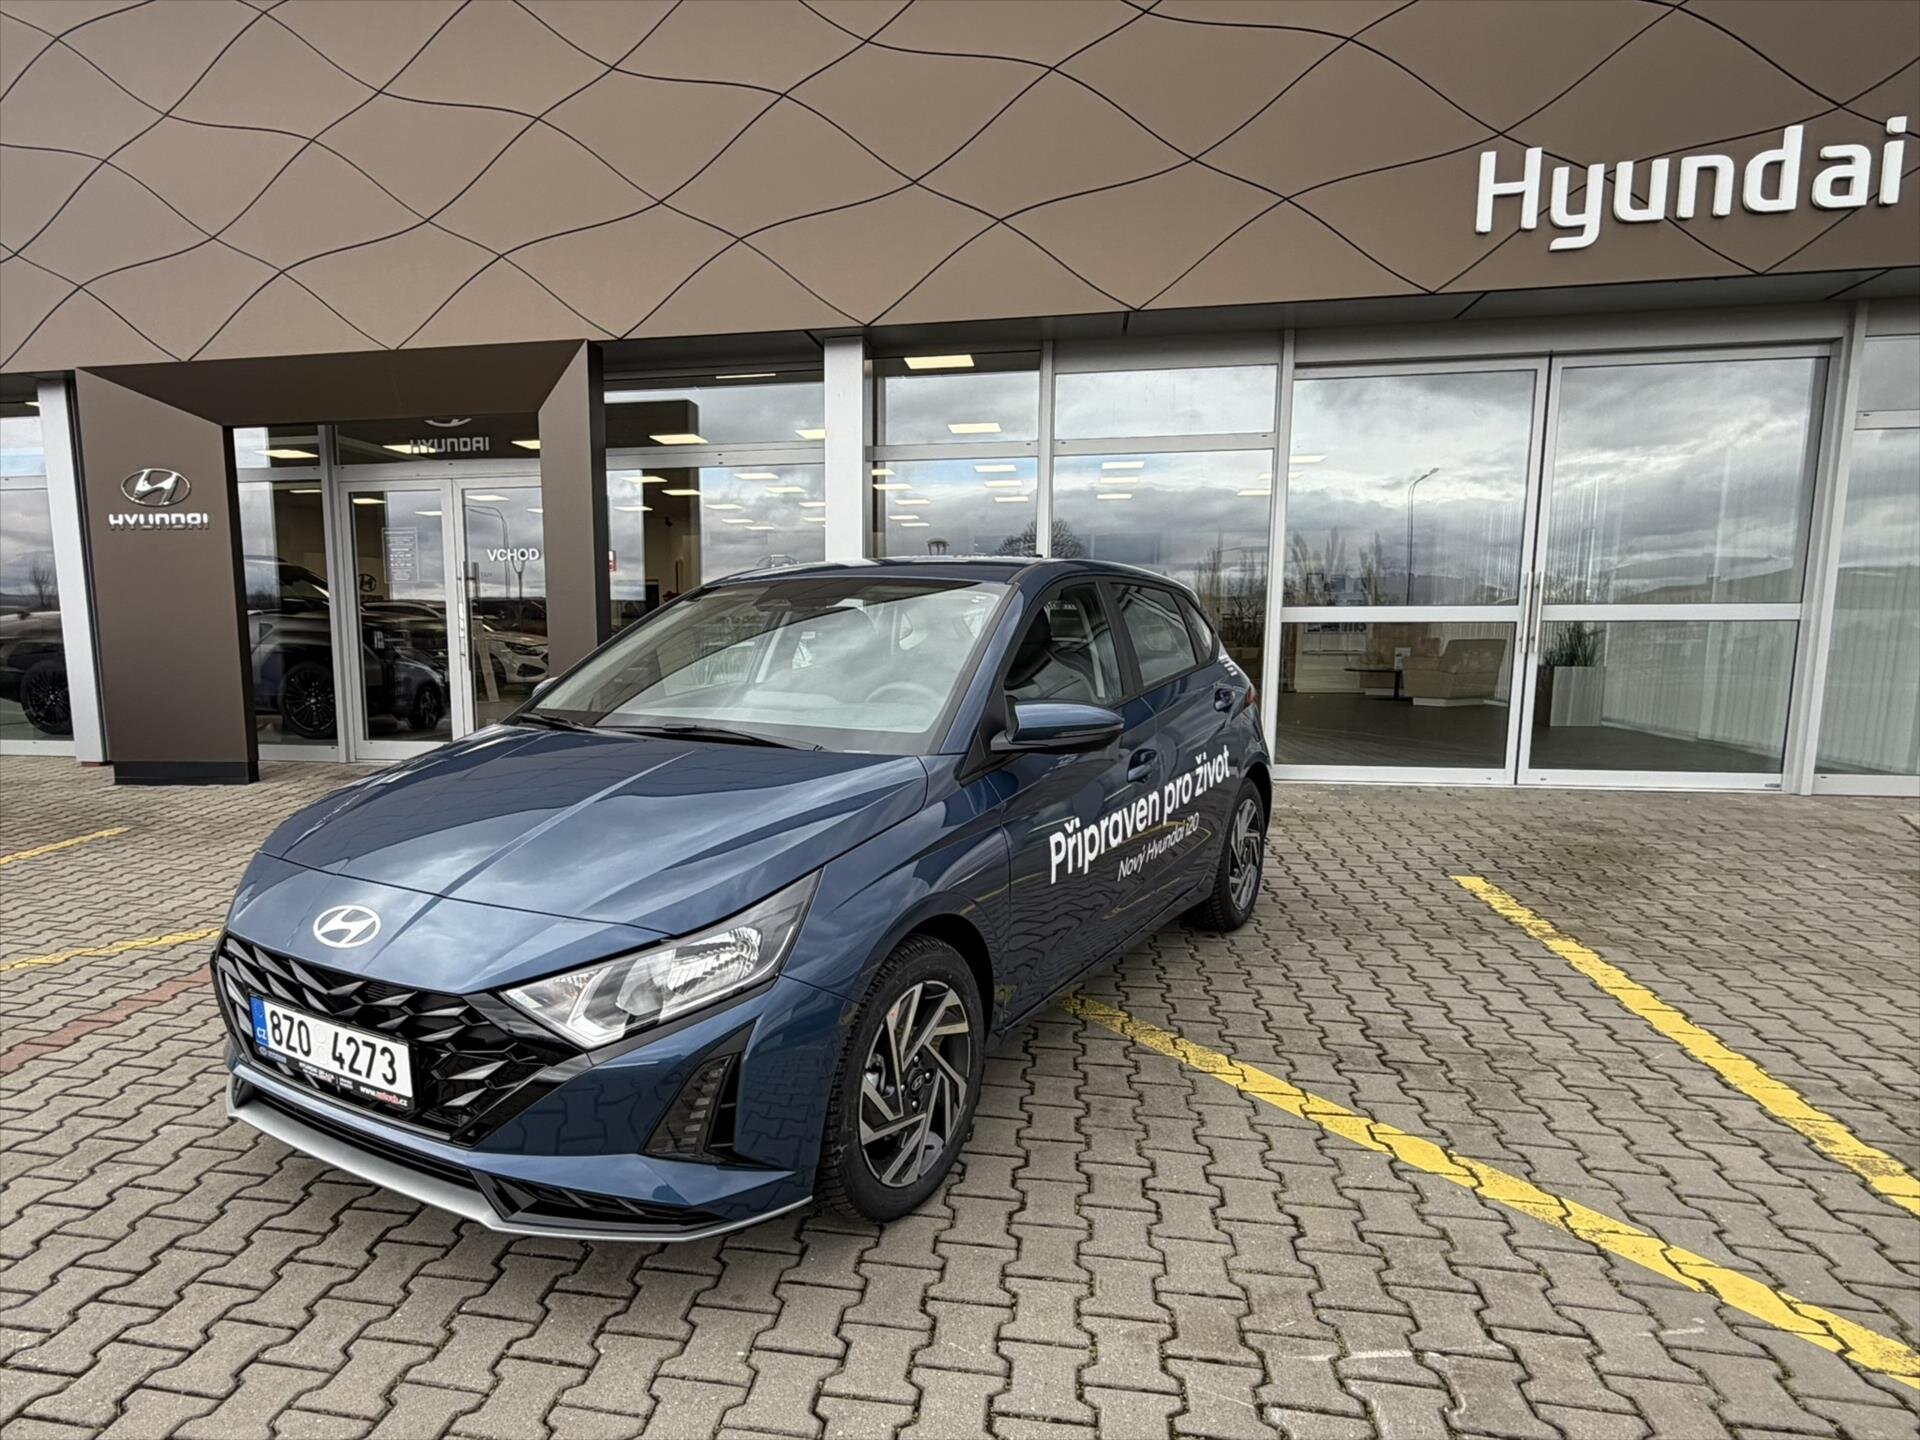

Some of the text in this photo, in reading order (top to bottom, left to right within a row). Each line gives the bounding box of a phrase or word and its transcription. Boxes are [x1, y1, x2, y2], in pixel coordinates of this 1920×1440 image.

[1475, 116, 1907, 252] Hyundai
[409, 436, 490, 454] HYUNDAI
[108, 512, 209, 530] HYUNDAI
[487, 548, 540, 561] VCHOD
[1049, 744, 1230, 885] Připraven pro život
[1117, 844, 1146, 882] Nový
[1145, 819, 1185, 863] Hyundai
[256, 1026, 268, 1041] CZ
[269, 1009, 312, 1058] 8Z0
[331, 1031, 397, 1086] 4273
